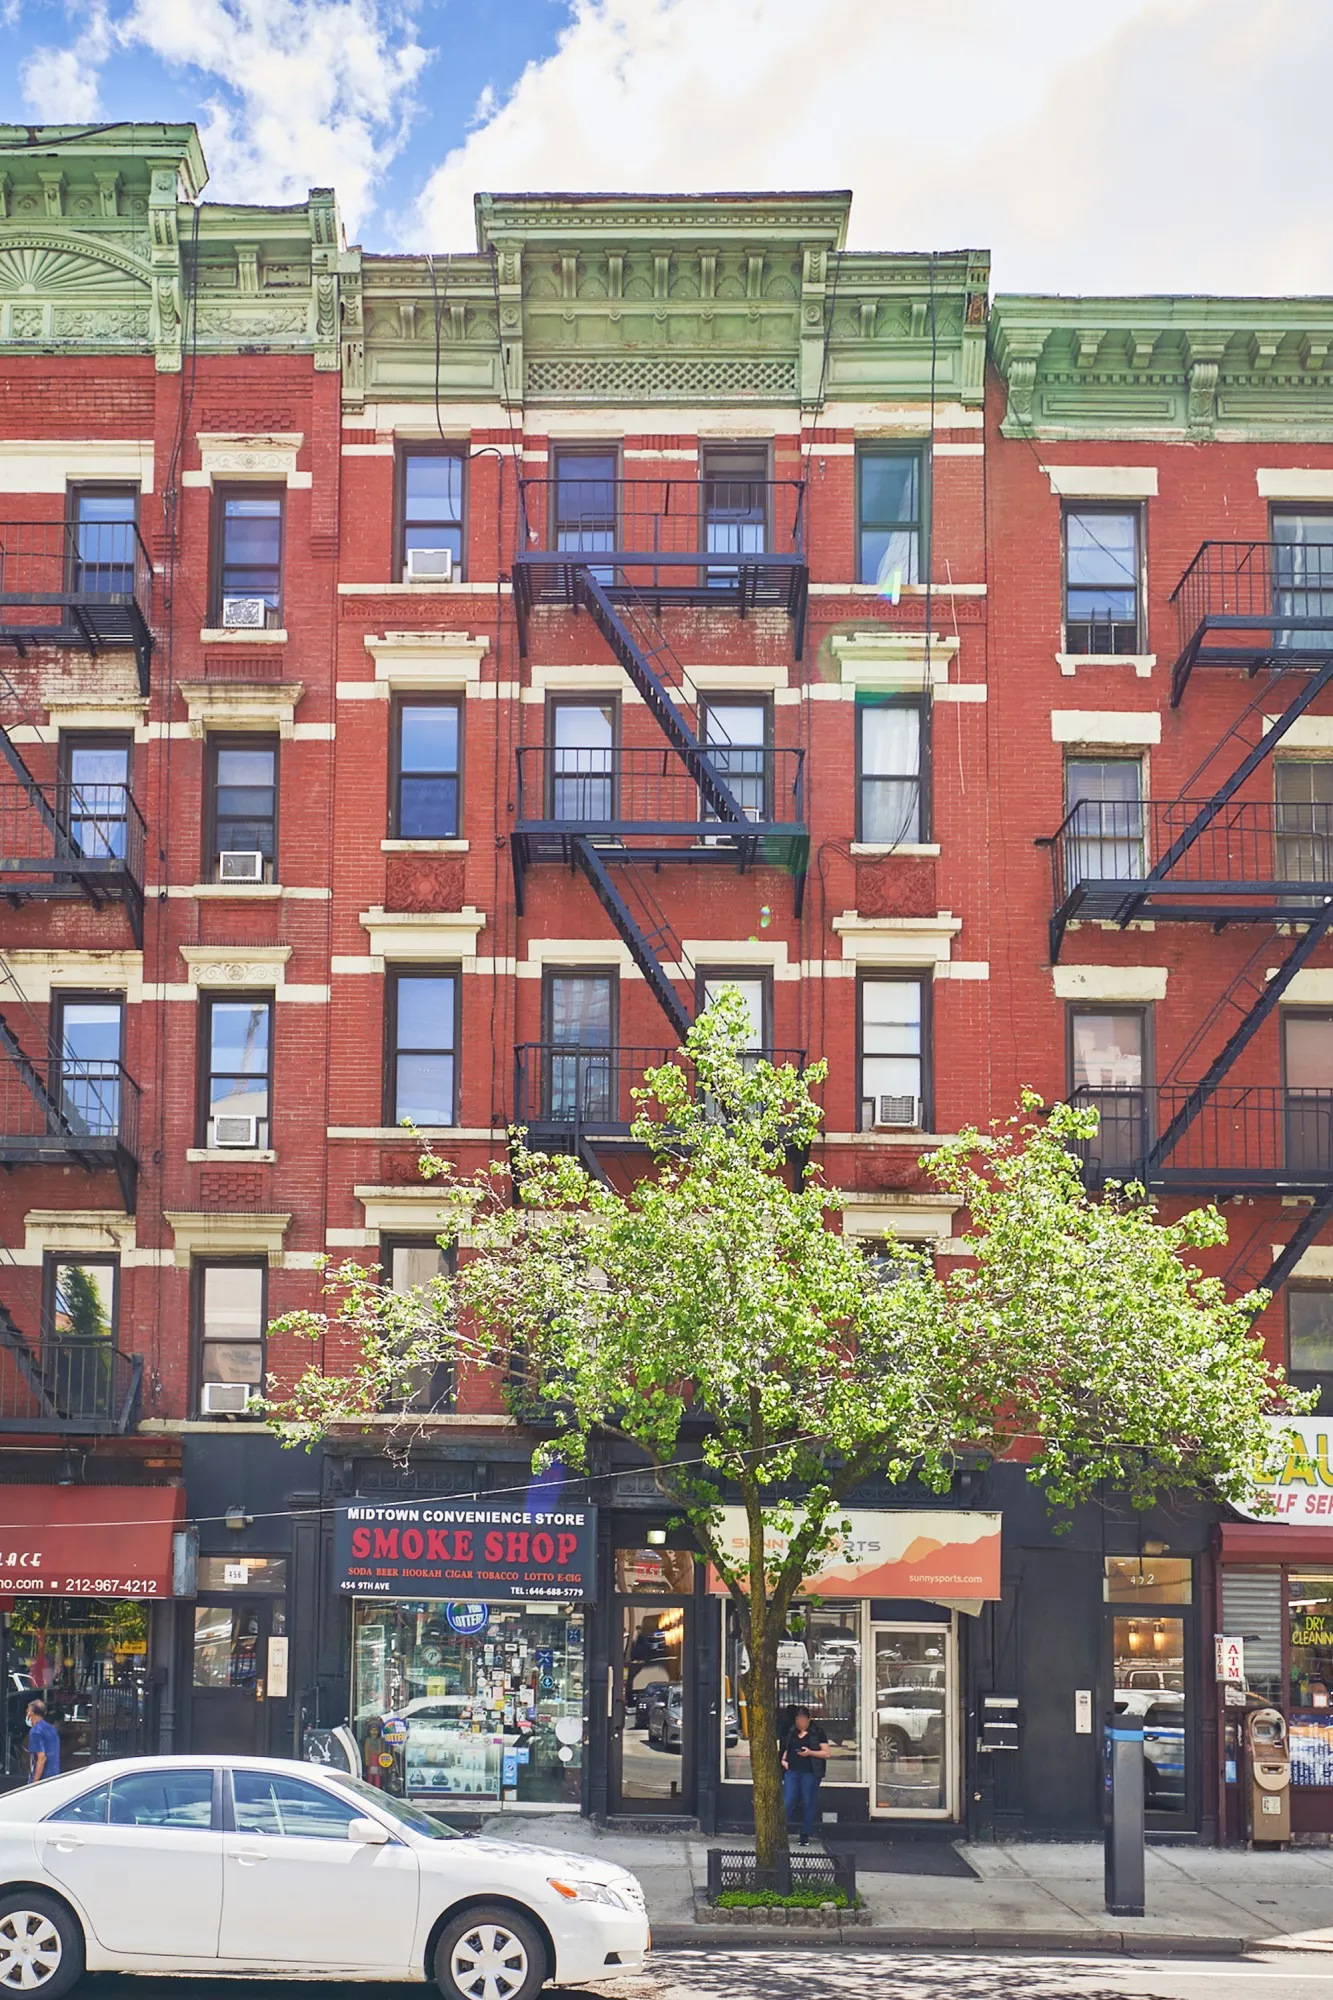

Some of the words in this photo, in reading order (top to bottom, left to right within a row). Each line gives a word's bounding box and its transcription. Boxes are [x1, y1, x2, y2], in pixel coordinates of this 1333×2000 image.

[347, 1508, 419, 1521] MIDTOWN
[423, 1510, 532, 1524] CONVENIENCE
[535, 1513, 585, 1526] STORE
[351, 1527, 474, 1562] SMOKE
[484, 1530, 577, 1565] SHOP
[228, 1570, 242, 1579] 456
[347, 1567, 373, 1576] SODA
[376, 1568, 399, 1577] BEER
[402, 1568, 442, 1578] HOOKAH
[445, 1569, 473, 1579] CIGAR
[477, 1571, 519, 1580] TOBACCO
[524, 1572, 555, 1581] LOTTO
[557, 1573, 582, 1583] E-CIG
[908, 1575, 983, 1584] sunnysports.com
[65, 1578, 157, 1593] 212-967-4212
[340, 1581, 356, 1590] 454
[1305, 1616, 1325, 1631] DRY
[1292, 1630, 1333, 1646] CLEANIN
[1228, 1644, 1240, 1678] ATM
